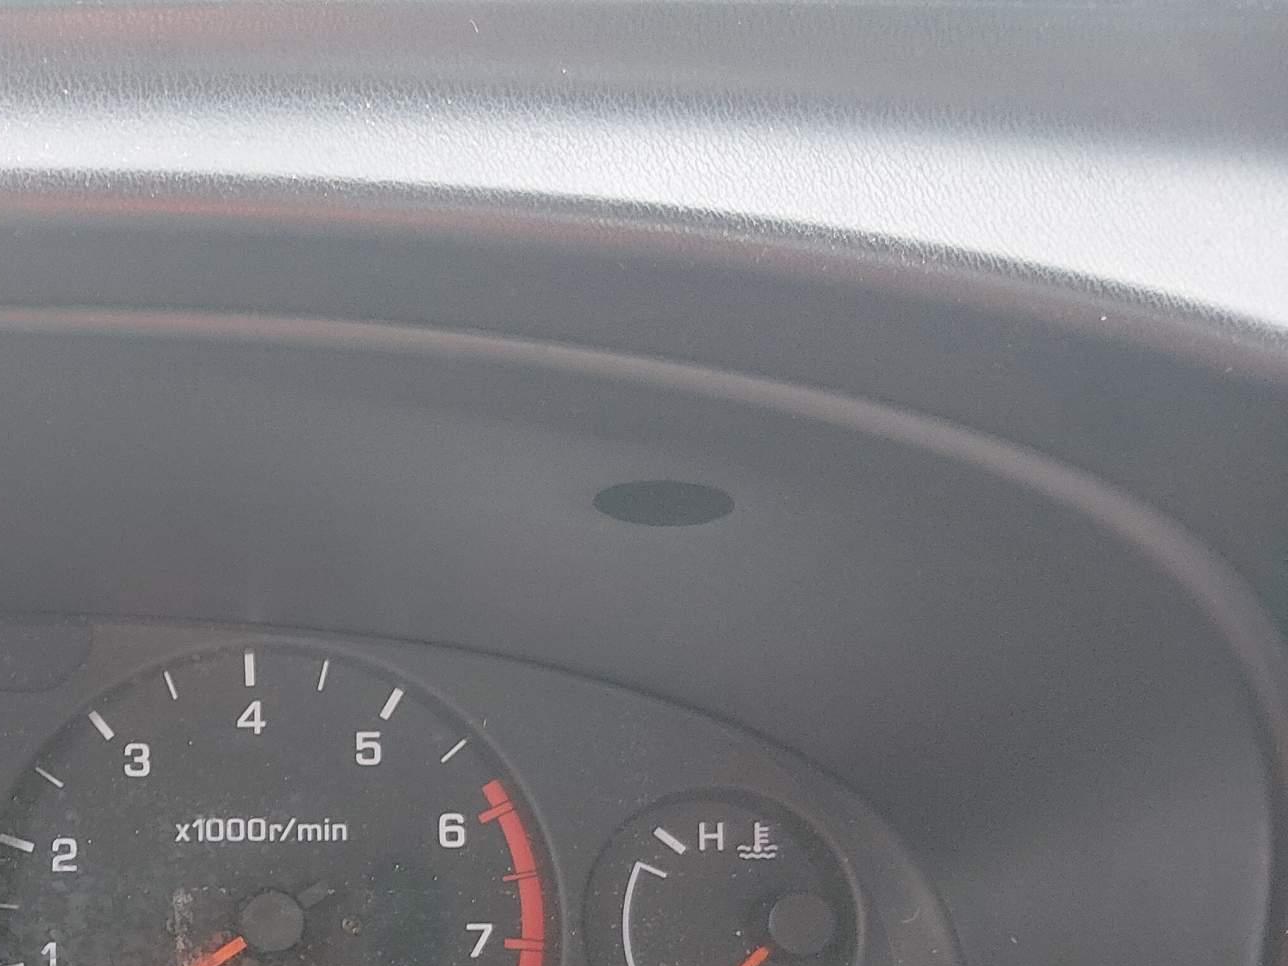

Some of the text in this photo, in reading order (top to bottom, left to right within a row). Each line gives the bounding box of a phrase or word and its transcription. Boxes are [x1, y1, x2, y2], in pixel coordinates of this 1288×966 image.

[236, 701, 266, 734] 4
[124, 743, 150, 777] 3
[355, 731, 382, 765] 5
[175, 818, 348, 844] x1000r/min
[438, 814, 465, 848] 6
[698, 822, 724, 850] H
[52, 838, 78, 872] 2
[465, 923, 492, 957] 7
